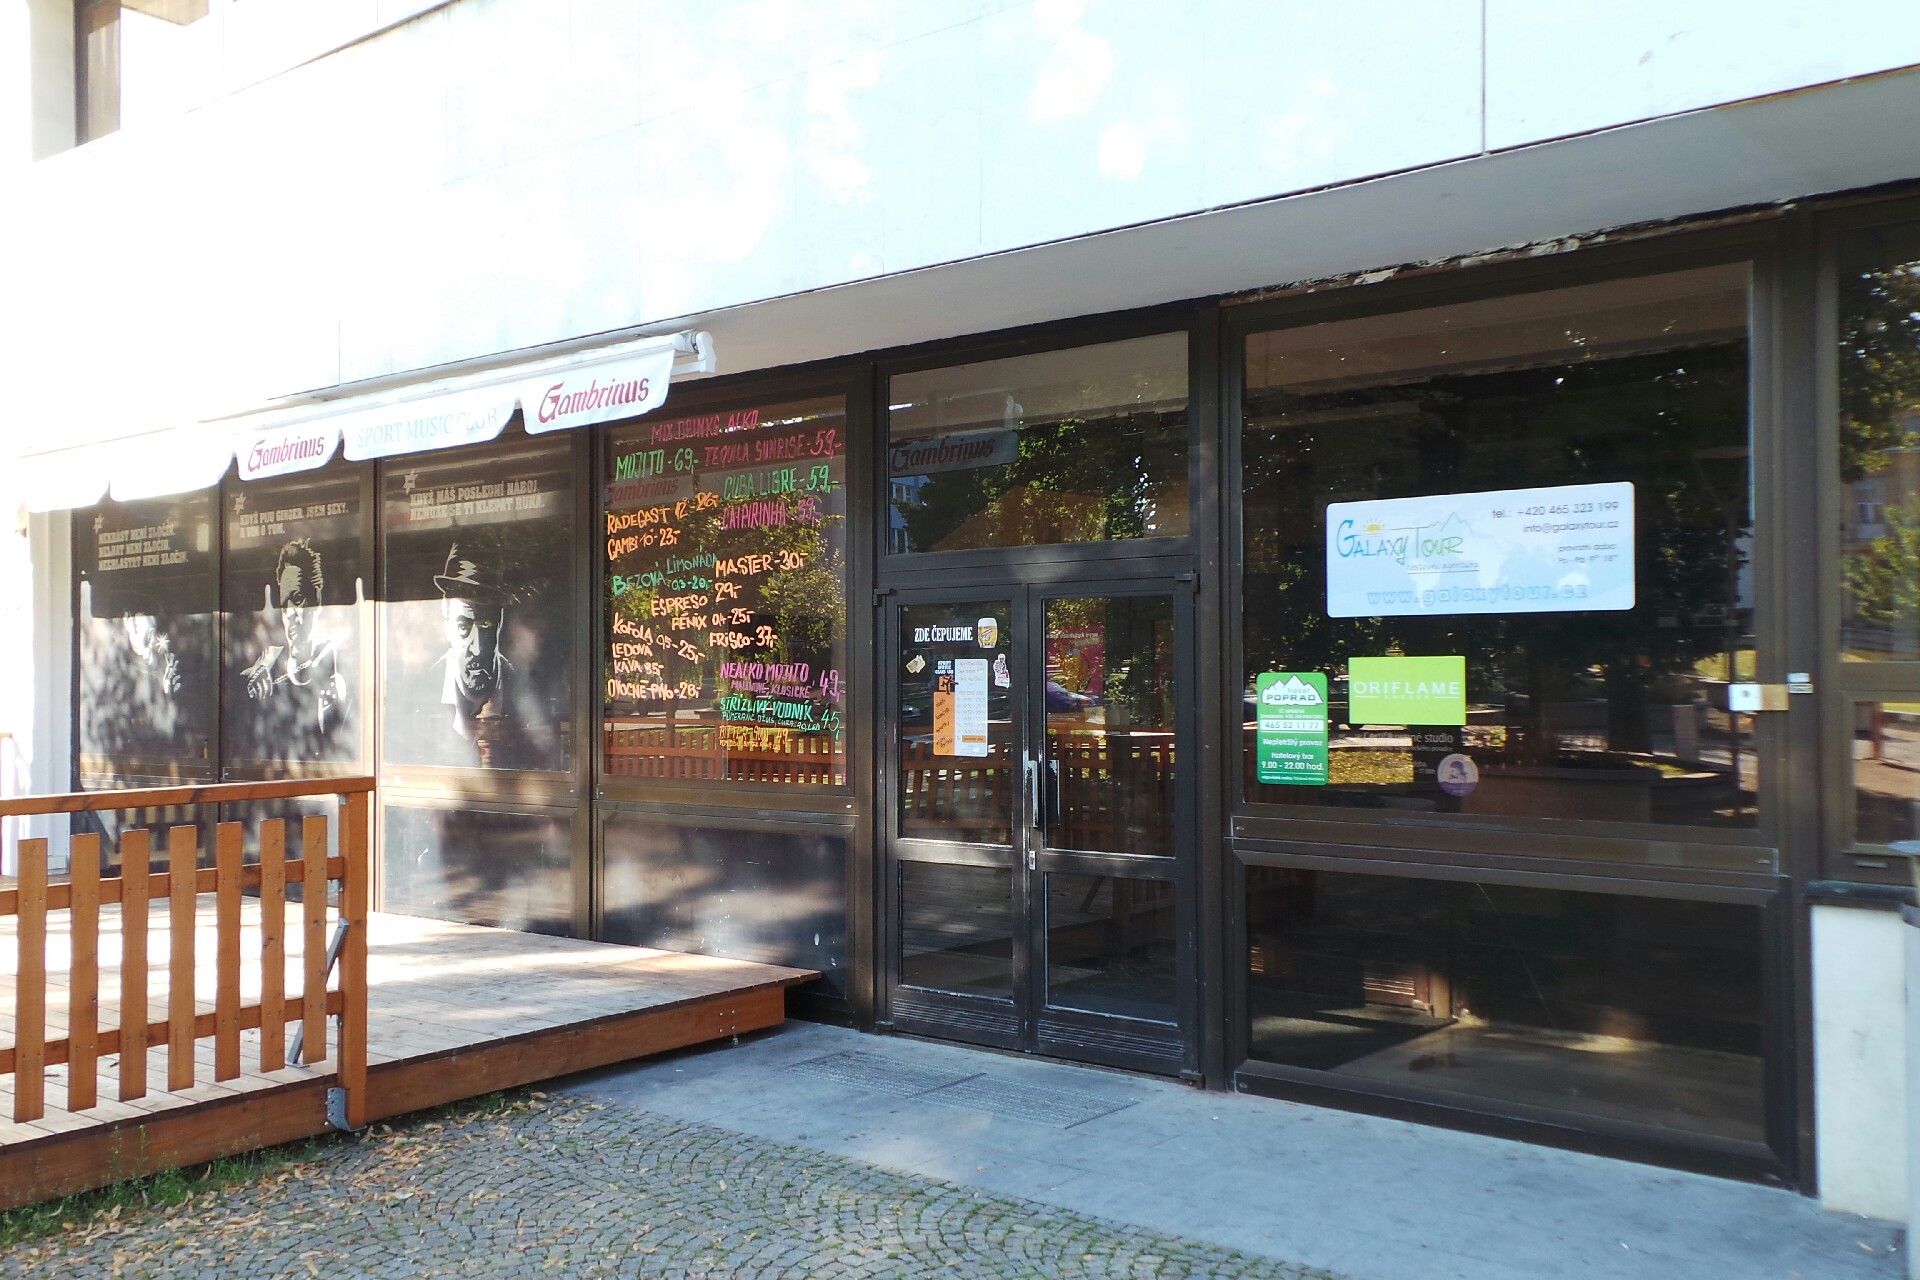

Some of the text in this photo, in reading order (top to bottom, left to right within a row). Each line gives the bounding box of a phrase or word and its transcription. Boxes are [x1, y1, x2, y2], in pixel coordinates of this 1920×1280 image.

[538, 377, 649, 423] Gambrinus
[358, 424, 402, 449] SPORT
[407, 413, 452, 439] MUSIC
[247, 435, 325, 473] Gambrinus
[704, 440, 749, 467] TEQUILA
[755, 434, 805, 462] SUNRISE
[615, 449, 665, 482] MOJITO
[436, 488, 456, 504] MÁŠ
[458, 481, 504, 501] POSLEDNÍ
[724, 474, 756, 501] CUBA
[760, 466, 797, 496] LIBRE
[722, 500, 786, 531] CAIPIRINHA
[1517, 506, 1546, 517] +420
[1549, 504, 1569, 515] 465
[1573, 502, 1594, 514] 323
[1597, 501, 1619, 512] 199
[608, 507, 670, 535] RADEGAST
[1523, 520, 1619, 534] info@galaxytour.cz
[715, 554, 773, 578] MASTER
[651, 594, 708, 618] ESPRESO
[1367, 583, 1588, 606] www.galaxytour.cz
[613, 611, 654, 643] KOFOLA
[914, 624, 974, 642] ZDE ČEPUJEME
[720, 661, 763, 680] NEALKO
[765, 662, 810, 683] MOJITO
[1353, 681, 1460, 695] ORIFLAME
[773, 699, 814, 722] VODNÍK
[1265, 721, 1280, 729] 465
[1282, 721, 1293, 729] 52
[1299, 739, 1323, 747] provoz
[1424, 732, 1454, 744] studio
[1261, 761, 1277, 769] 9.00
[1284, 761, 1305, 770] 22.00
[1306, 762, 1324, 771] hod.
[1271, 752, 1314, 760] Hotelový bar
